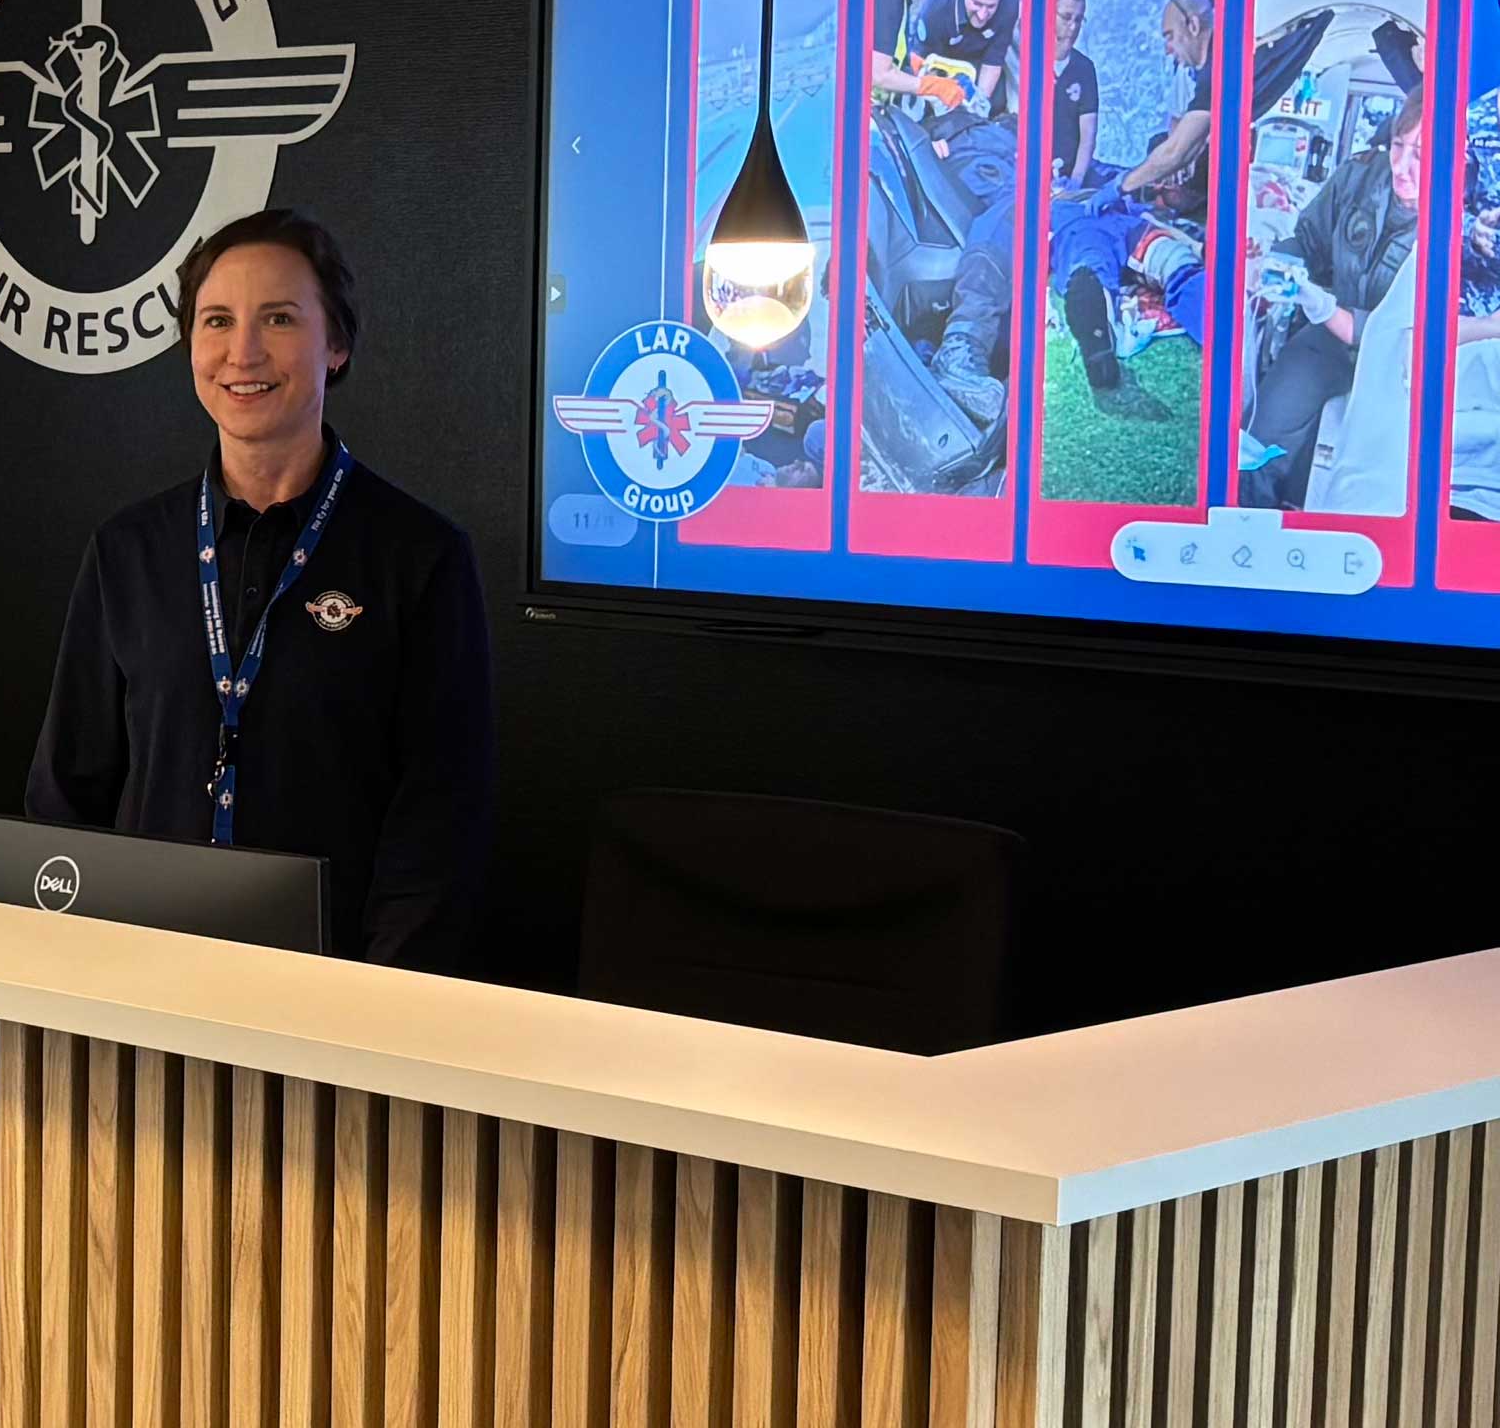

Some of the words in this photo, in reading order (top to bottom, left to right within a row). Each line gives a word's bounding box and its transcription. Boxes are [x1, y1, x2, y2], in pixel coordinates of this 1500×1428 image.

[635, 325, 692, 357] LAR
[622, 483, 695, 514] Group
[39, 874, 74, 895] DELL
